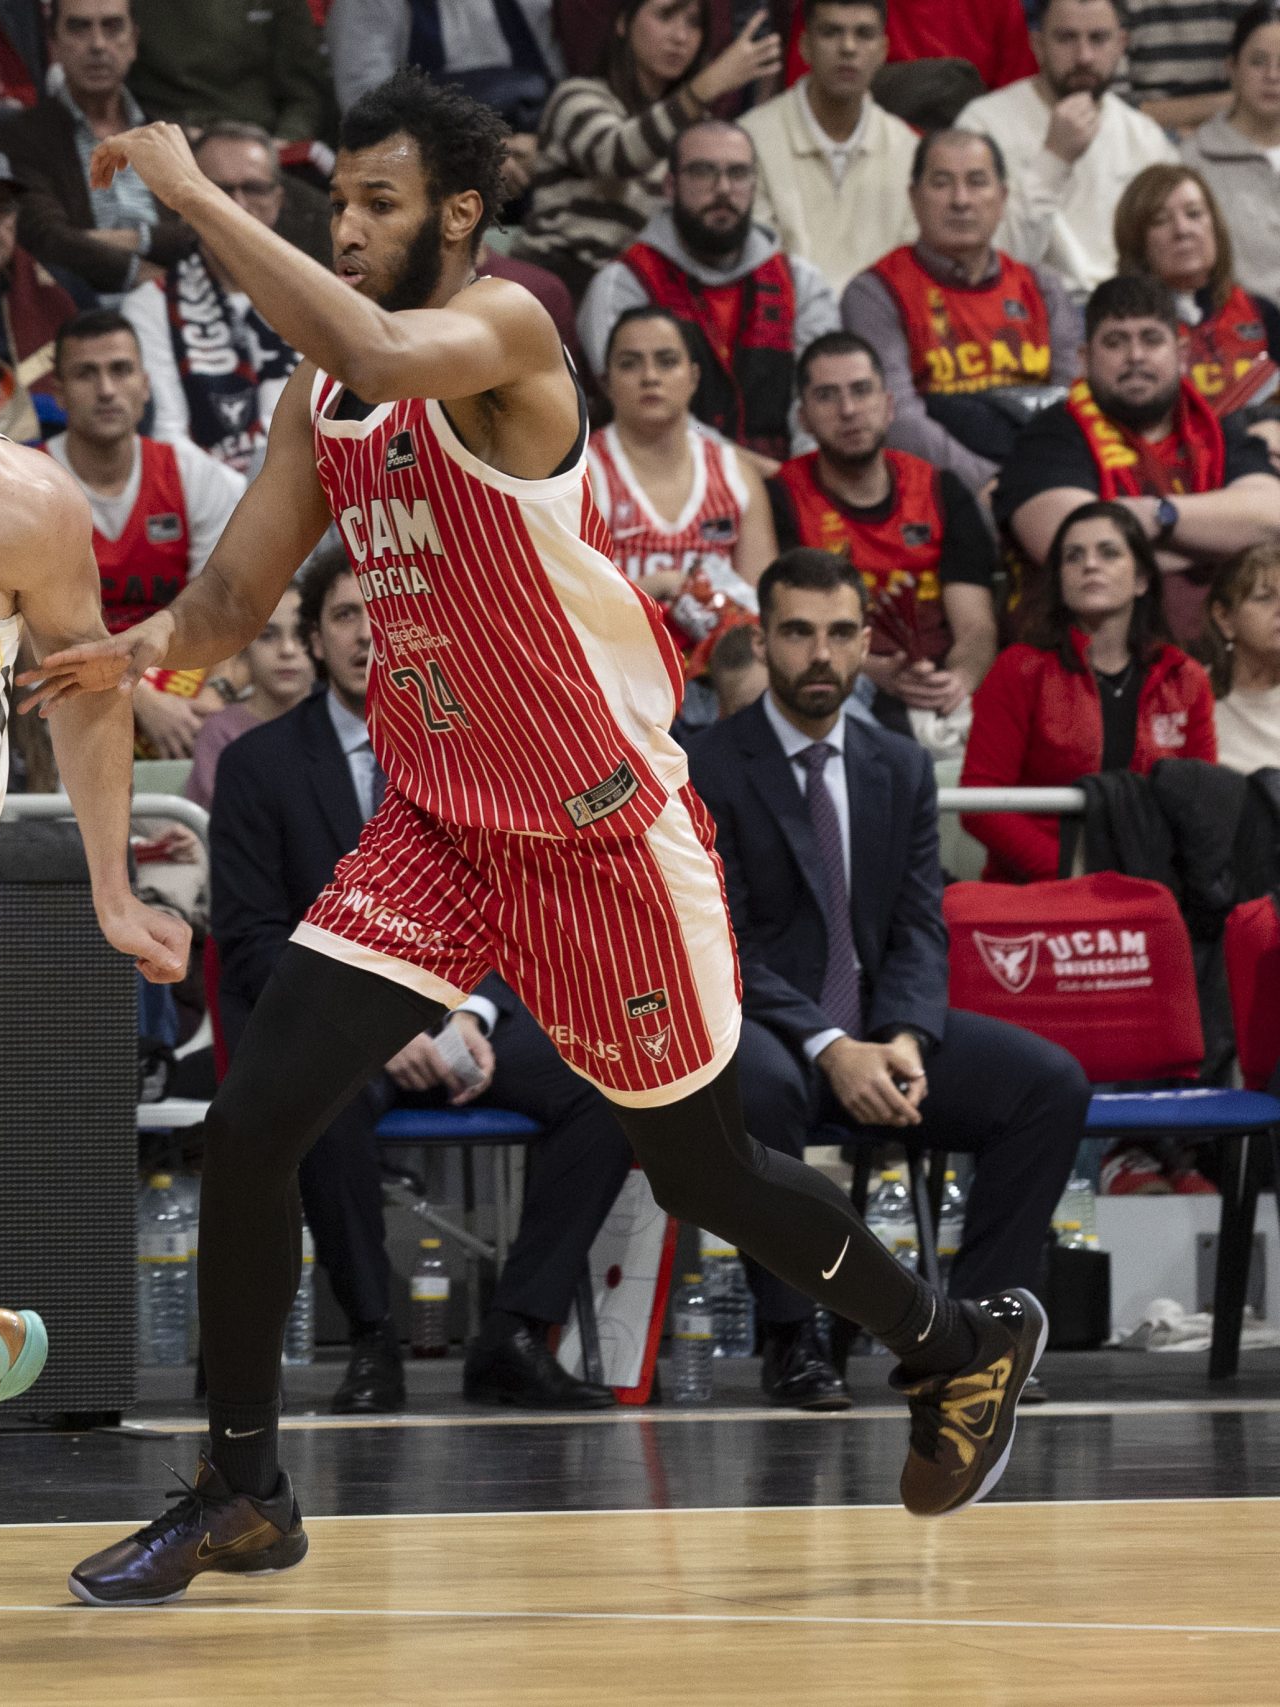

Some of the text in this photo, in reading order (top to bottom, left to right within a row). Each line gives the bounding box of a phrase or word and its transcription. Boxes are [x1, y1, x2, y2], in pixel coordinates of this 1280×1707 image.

[340, 498, 443, 564] CAM
[359, 566, 432, 602] URCIA
[393, 634, 452, 656] DE MURCIA
[390, 660, 471, 732] 24
[1047, 929, 1146, 960] UCAM
[631, 1001, 659, 1016] acb
